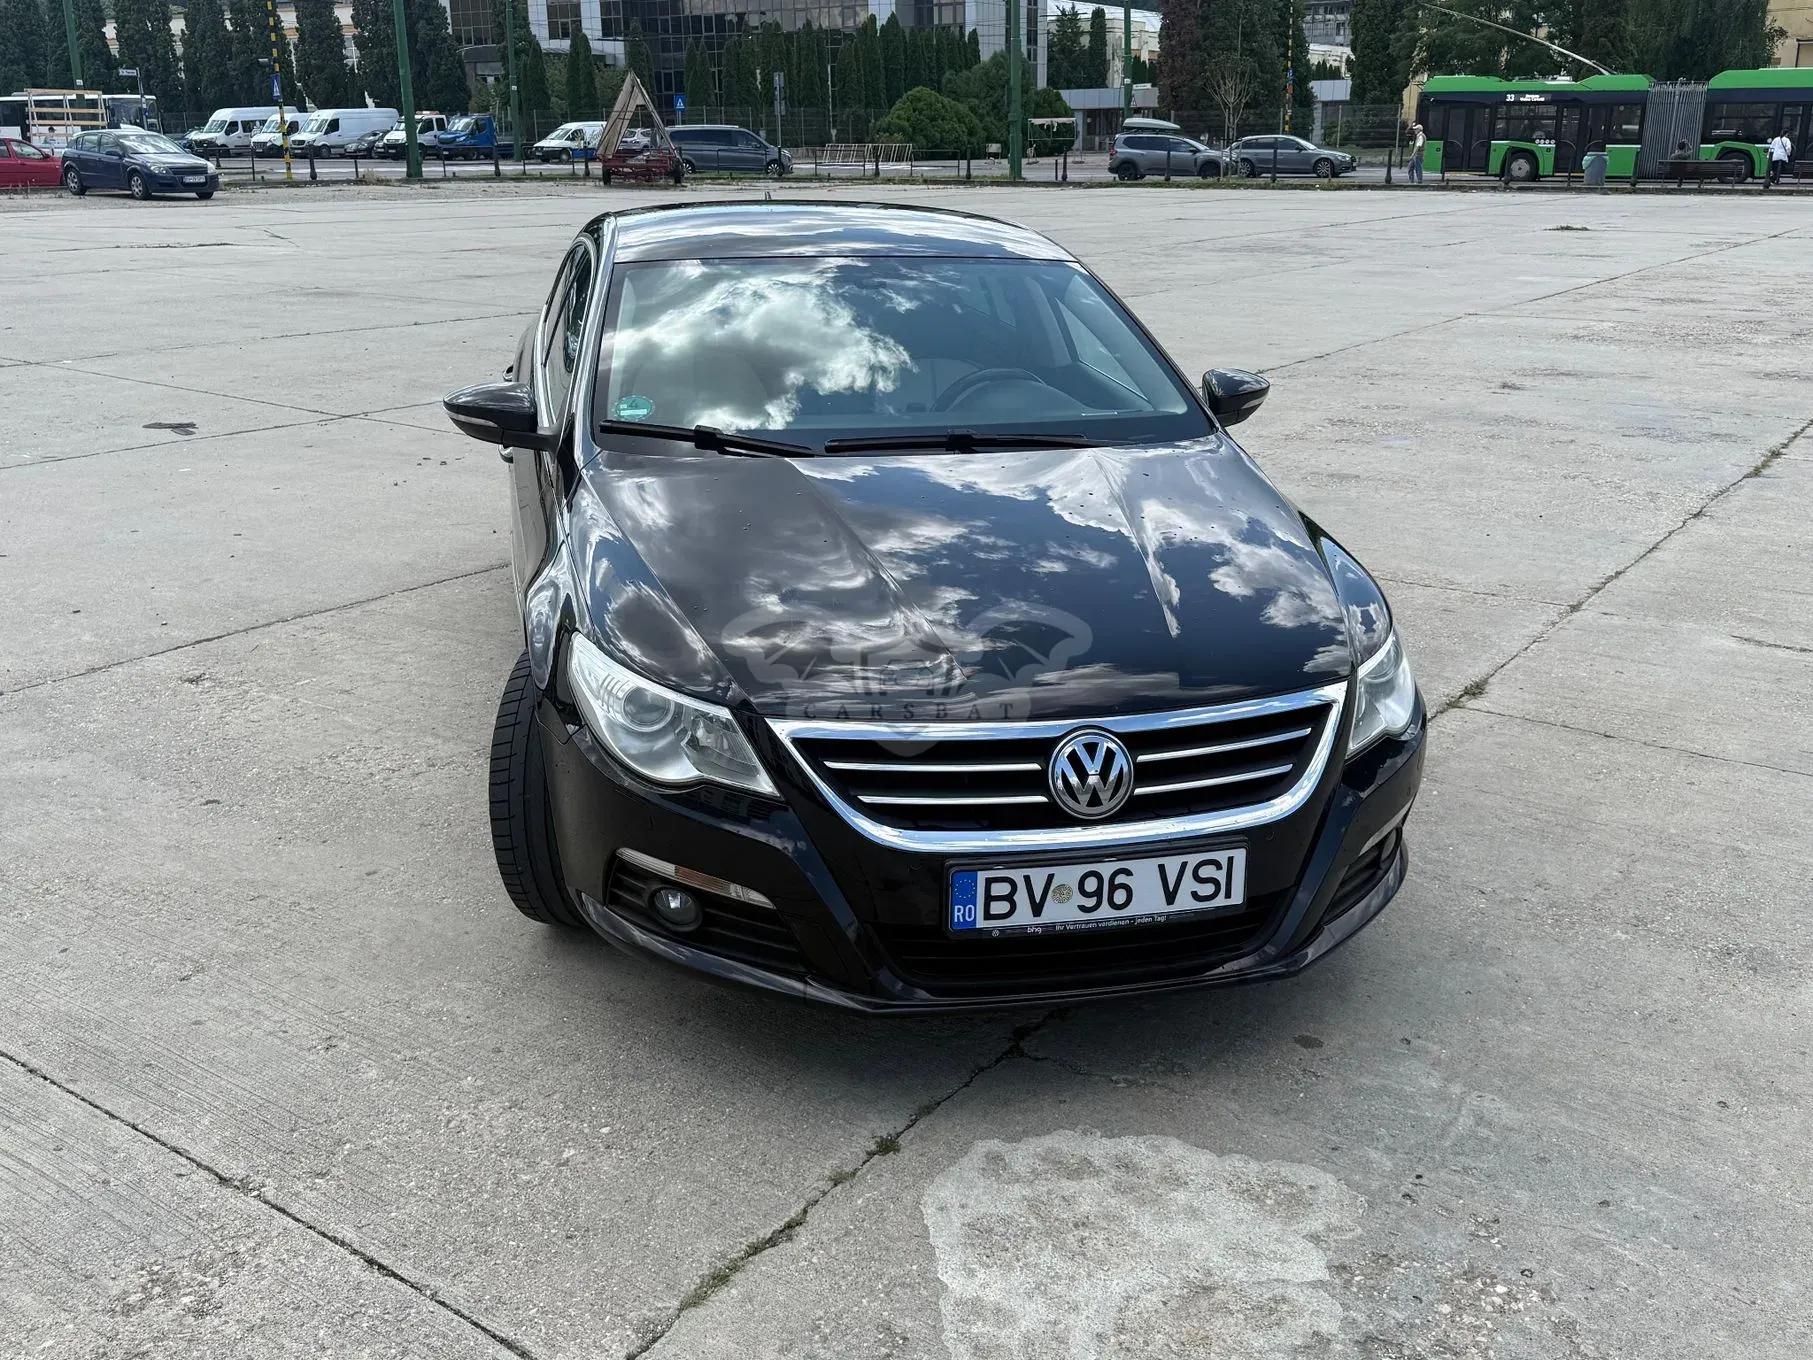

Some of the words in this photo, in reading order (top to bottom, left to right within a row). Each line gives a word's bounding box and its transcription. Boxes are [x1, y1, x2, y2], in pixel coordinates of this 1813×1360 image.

[1505, 94, 1515, 102] 33
[629, 399, 638, 408] 4
[1054, 735, 1130, 815] VW
[984, 873, 1055, 921] BV
[1077, 867, 1134, 914] 96
[1157, 856, 1234, 906] VSI
[953, 904, 975, 923] RO
